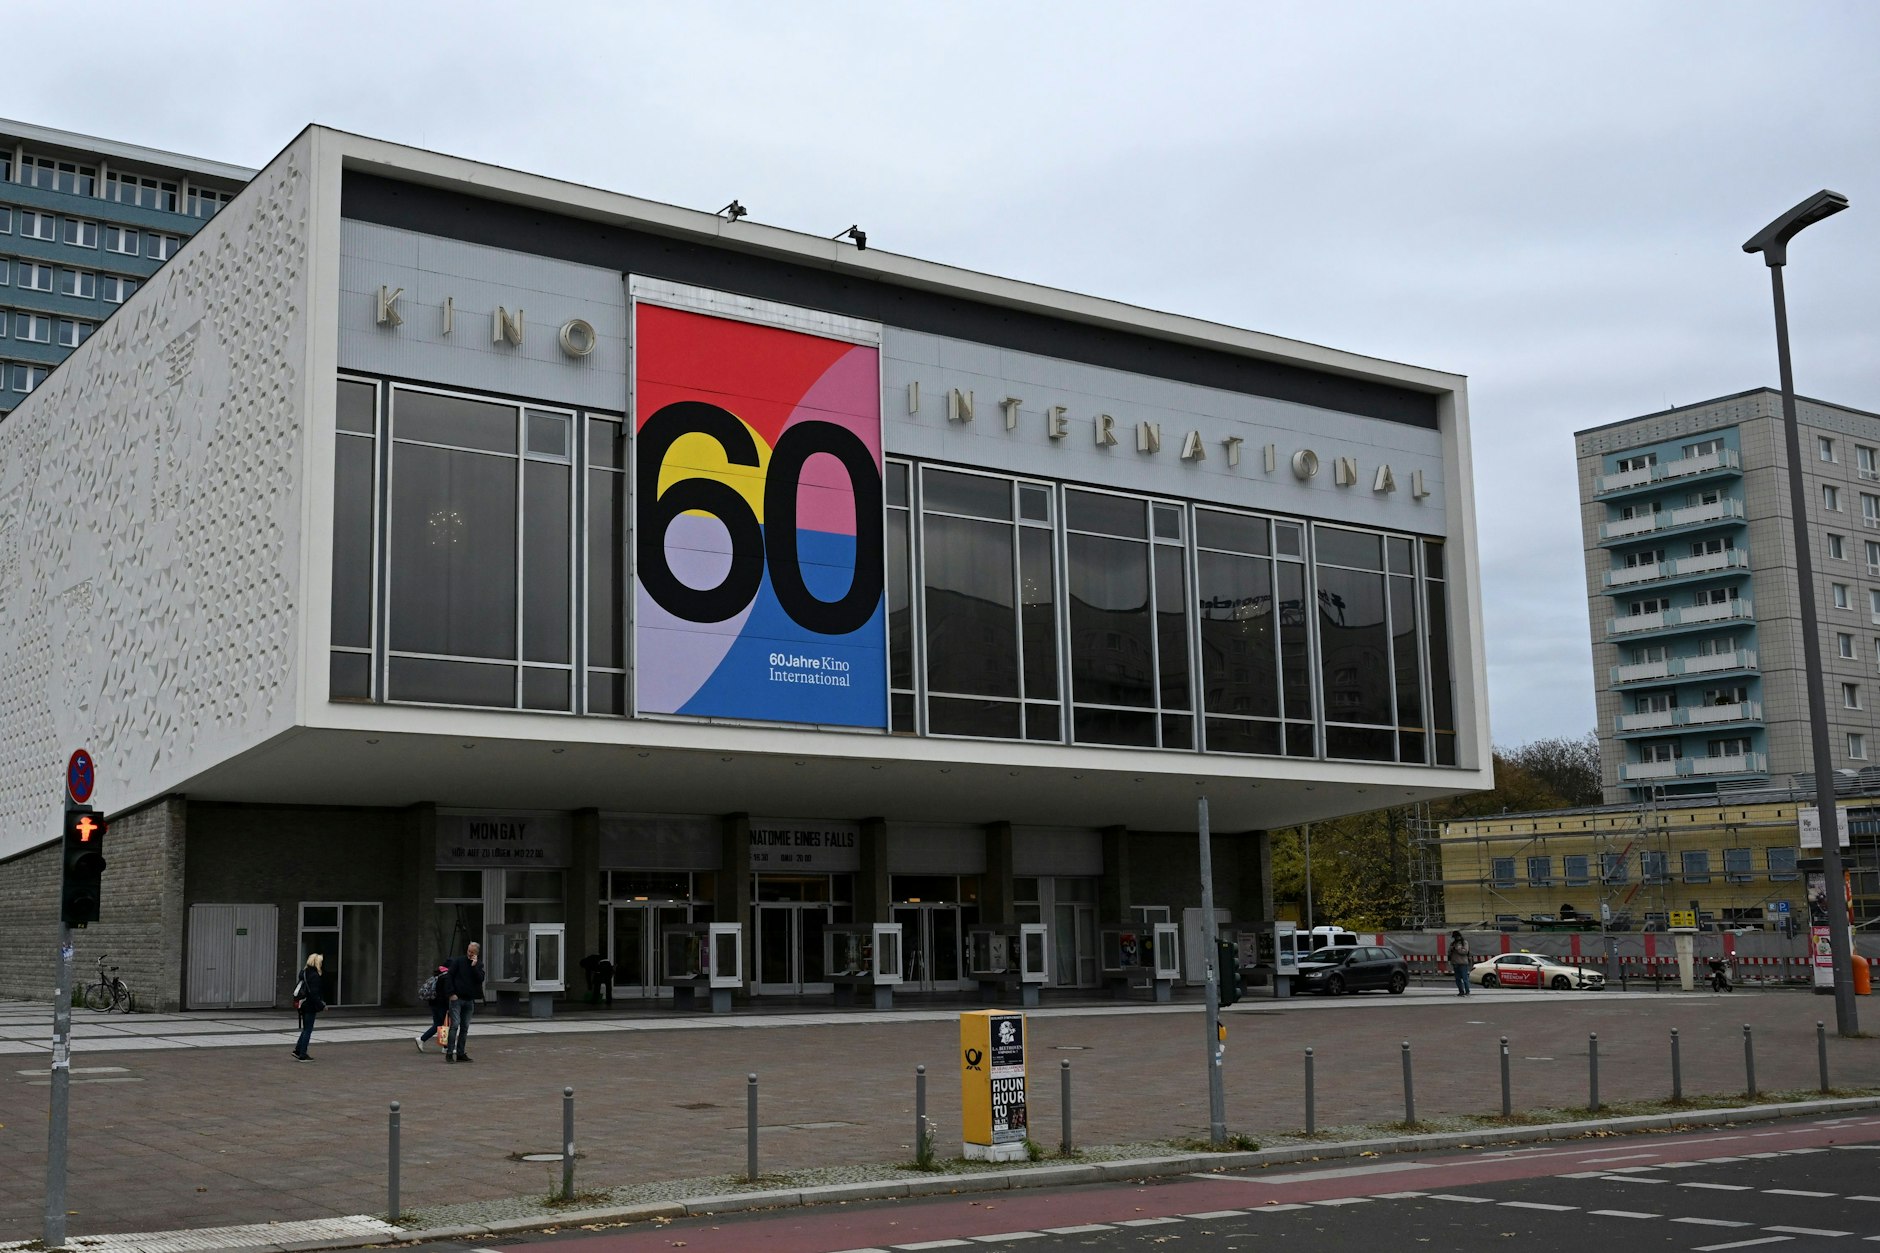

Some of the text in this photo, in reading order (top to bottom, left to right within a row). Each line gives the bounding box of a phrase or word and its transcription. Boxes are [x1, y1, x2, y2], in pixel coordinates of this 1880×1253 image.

[376, 284, 598, 359] KINO
[906, 380, 1432, 500] INTERNATIONAL
[636, 401, 884, 635] 60
[821, 656, 850, 671] Kino
[769, 668, 850, 687] International
[470, 823, 525, 840] MONGAY
[750, 829, 854, 848] NATOMIE EINES FALLS
[992, 1078, 1024, 1092] HUUN
[993, 1090, 1025, 1105] HUUR
[993, 1105, 1008, 1118] TU
